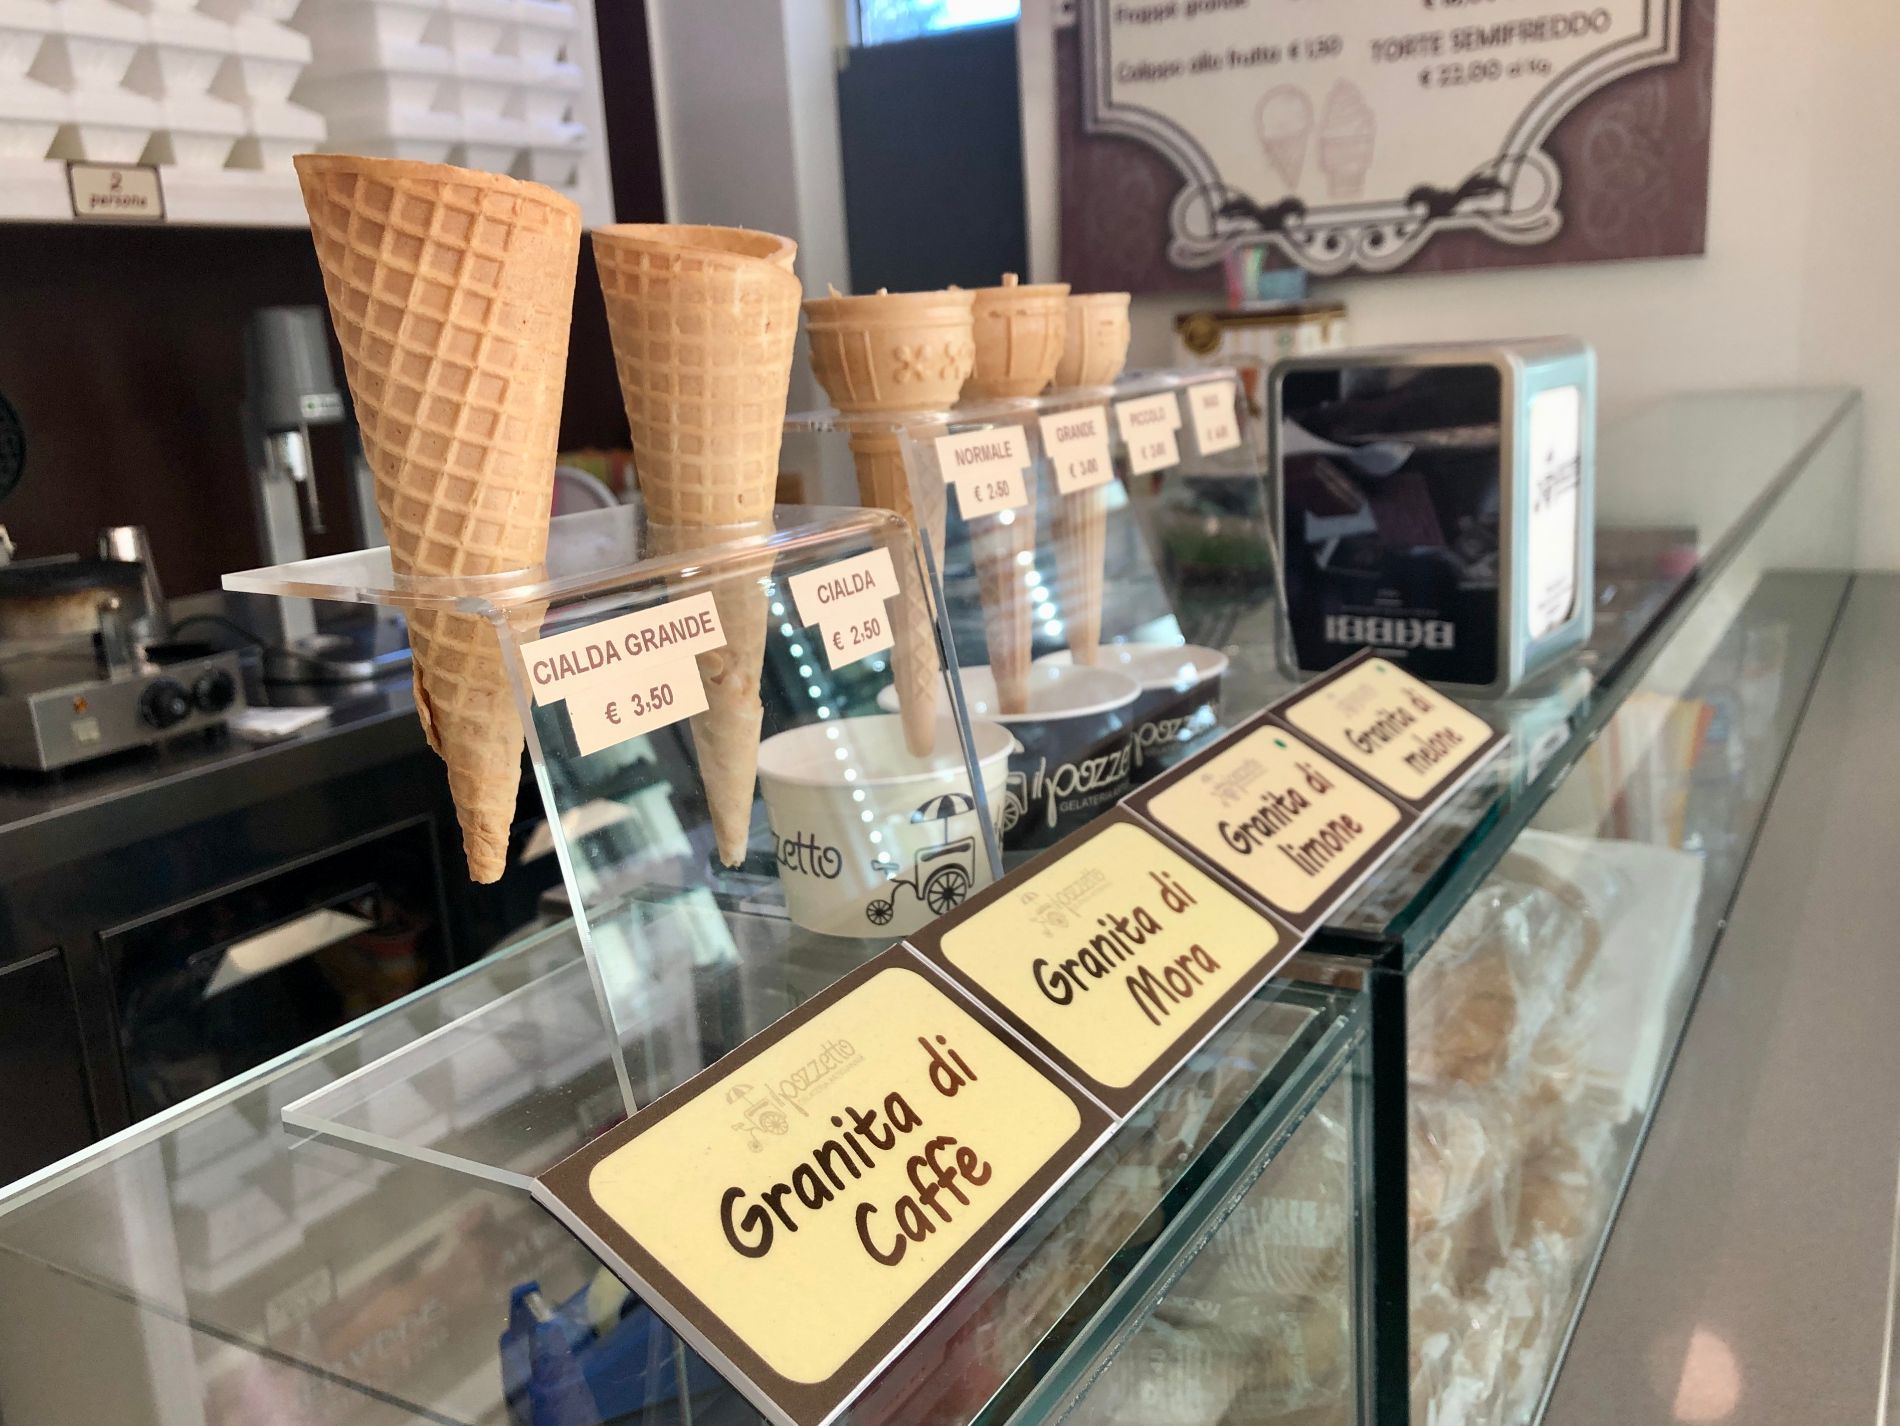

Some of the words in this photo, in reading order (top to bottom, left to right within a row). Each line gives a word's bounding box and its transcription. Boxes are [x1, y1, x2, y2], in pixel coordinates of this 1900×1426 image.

[1287, 41, 1299, 60] €
[1371, 30, 1442, 62] TORTE
[1450, 8, 1611, 52] SEMIFREDDO
[1417, 66, 1431, 88] €
[110, 170, 123, 191] 2
[954, 441, 1013, 466] NORMALE
[1056, 420, 1097, 443] GRANDE
[1069, 463, 1077, 478] €
[974, 485, 984, 502] €
[817, 569, 876, 604] CIALDA
[533, 639, 622, 686] CIALDA
[624, 610, 716, 657] GRANDE
[832, 631, 845, 651] €
[850, 617, 881, 645] 2,50
[605, 701, 622, 725] €
[631, 683, 674, 718] 3,50
[1344, 706, 1416, 754] Granita
[1400, 686, 1433, 713] di
[1403, 728, 1464, 775] melone
[1217, 787, 1312, 855] Granita
[1294, 762, 1336, 795] di
[1277, 813, 1364, 877] limone
[1032, 913, 1164, 1006] Granita
[1148, 870, 1198, 914] di
[1125, 943, 1221, 1026] Mora
[778, 1039, 856, 1117] pozzetto
[720, 1091, 923, 1259] Granita
[917, 1034, 979, 1098] di
